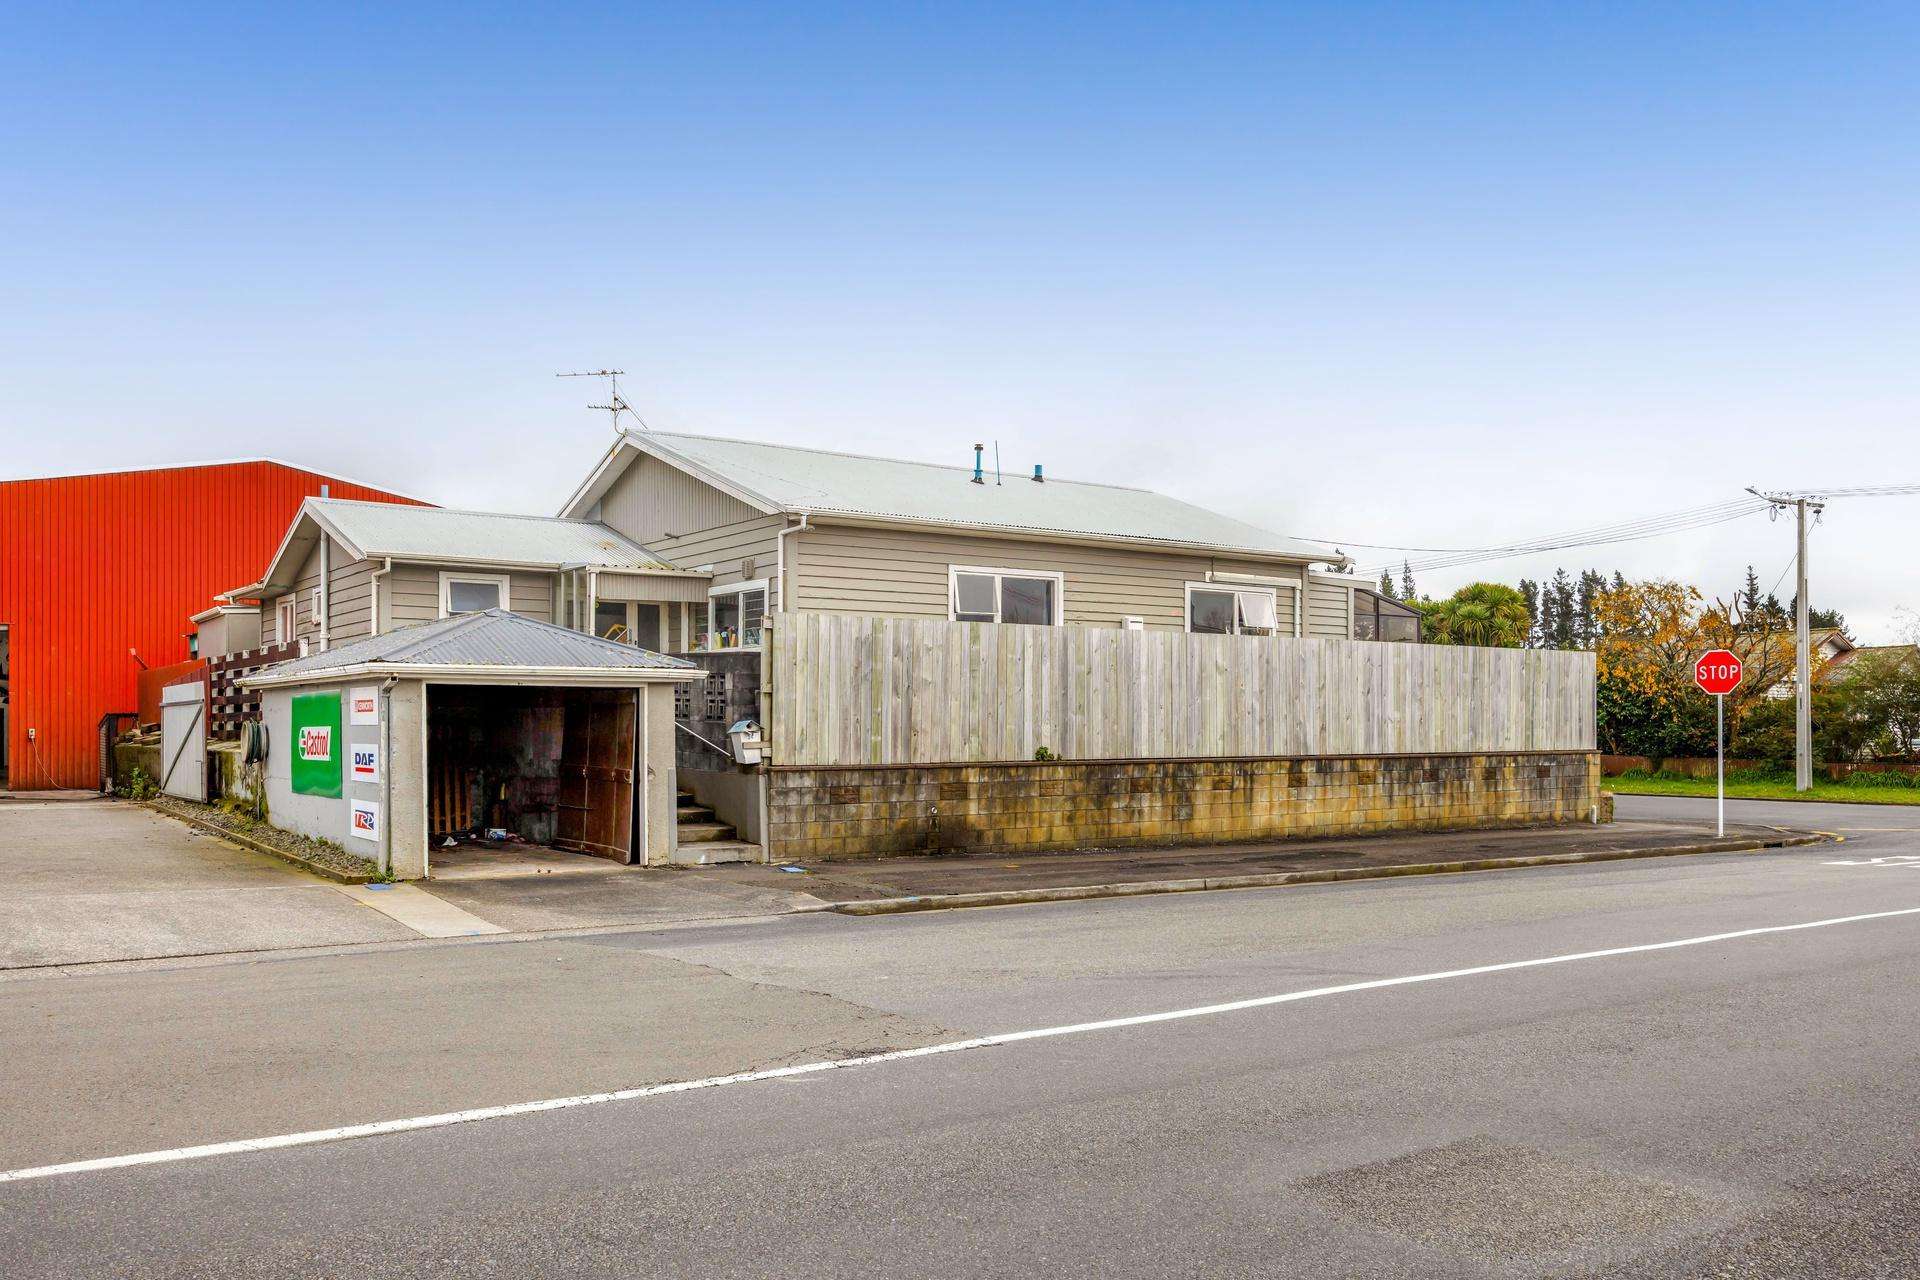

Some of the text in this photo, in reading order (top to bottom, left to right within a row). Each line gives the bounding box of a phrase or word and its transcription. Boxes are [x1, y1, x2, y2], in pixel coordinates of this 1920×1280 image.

[1699, 664, 1739, 680] STOP
[306, 730, 329, 756] Castrol
[354, 752, 375, 766] DAF
